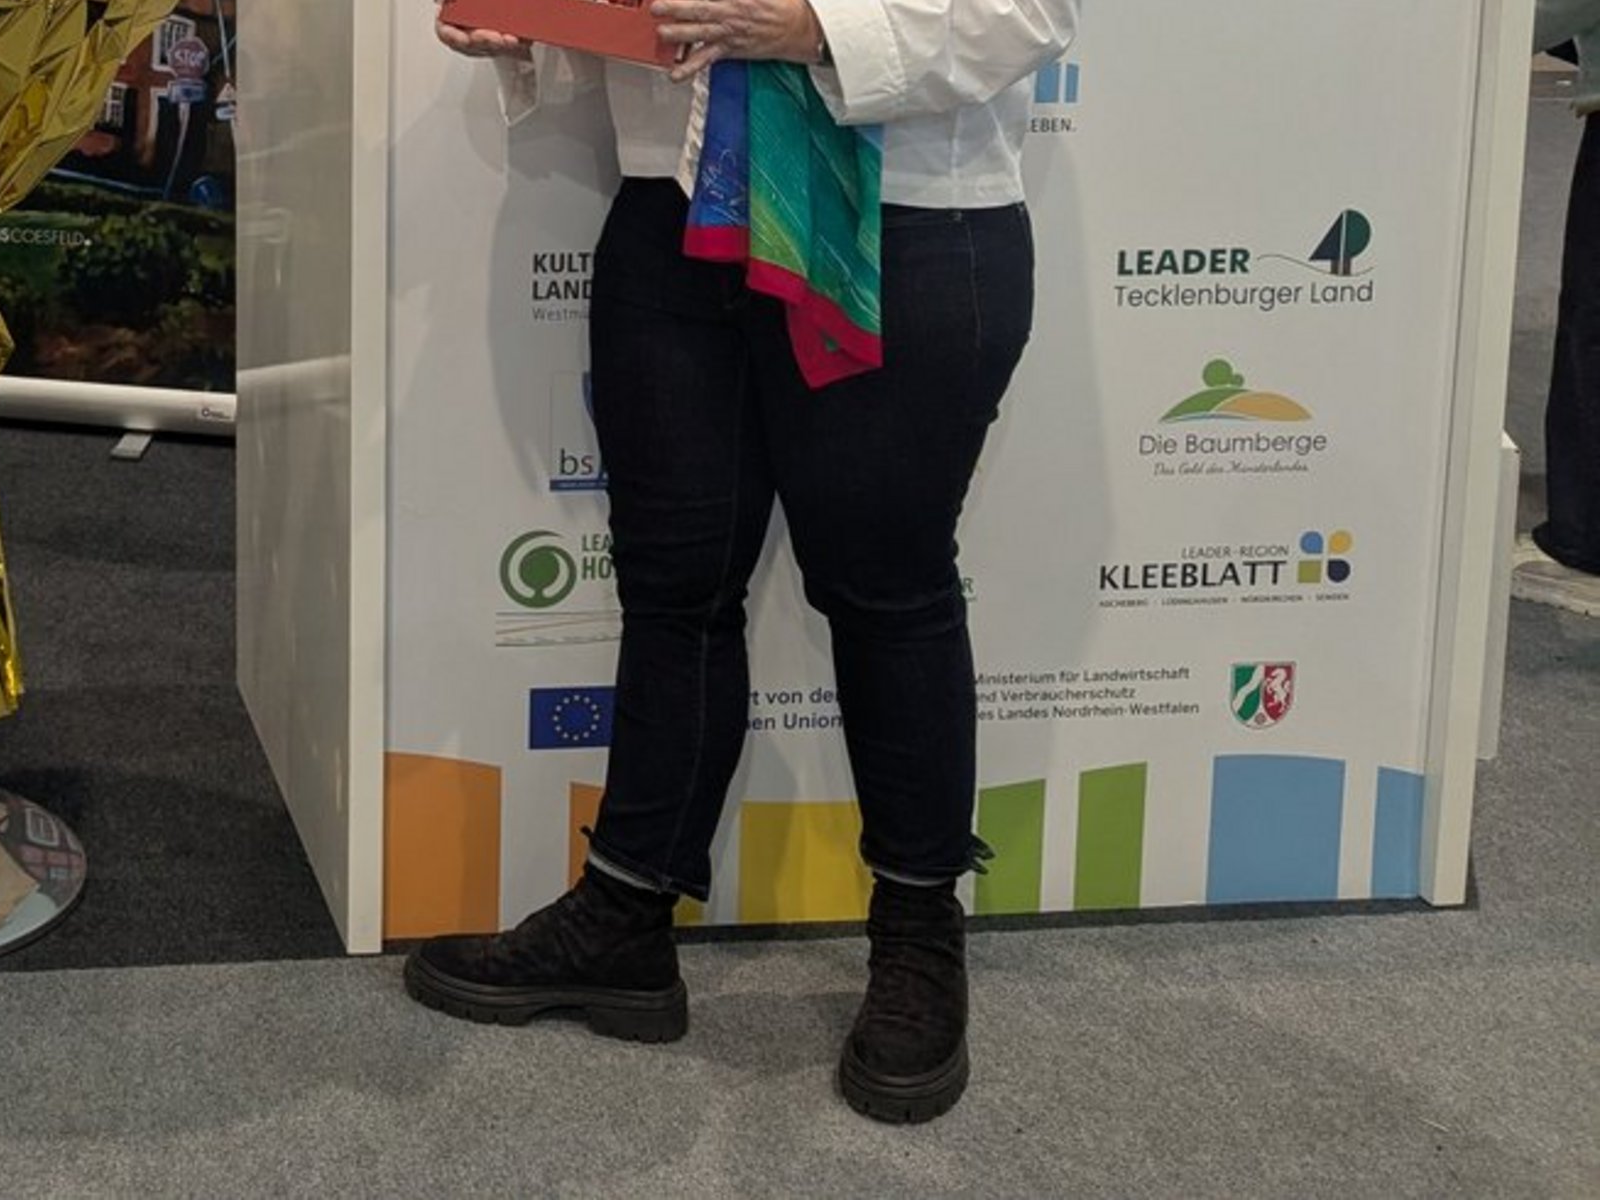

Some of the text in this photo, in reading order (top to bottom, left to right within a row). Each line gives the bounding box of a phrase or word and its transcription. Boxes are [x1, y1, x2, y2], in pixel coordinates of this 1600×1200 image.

[1026, 117, 1077, 133] EBEN.
[533, 252, 593, 274] KULT
[1116, 248, 1251, 276] LEADER
[1114, 280, 1374, 311] Tecklenburger Land
[1139, 432, 1328, 456] Die Baumberge
[582, 533, 613, 552] LEA
[1099, 560, 1288, 590] KLEEBLATT
[1059, 669, 1079, 683] für
[1083, 667, 1190, 682] Landwirtschaft
[764, 690, 803, 705] von
[977, 687, 1137, 703] nd Verbraucherschutz
[977, 702, 1200, 720] es Landes Nordrhein-Westfalen
[783, 712, 842, 729] Union
